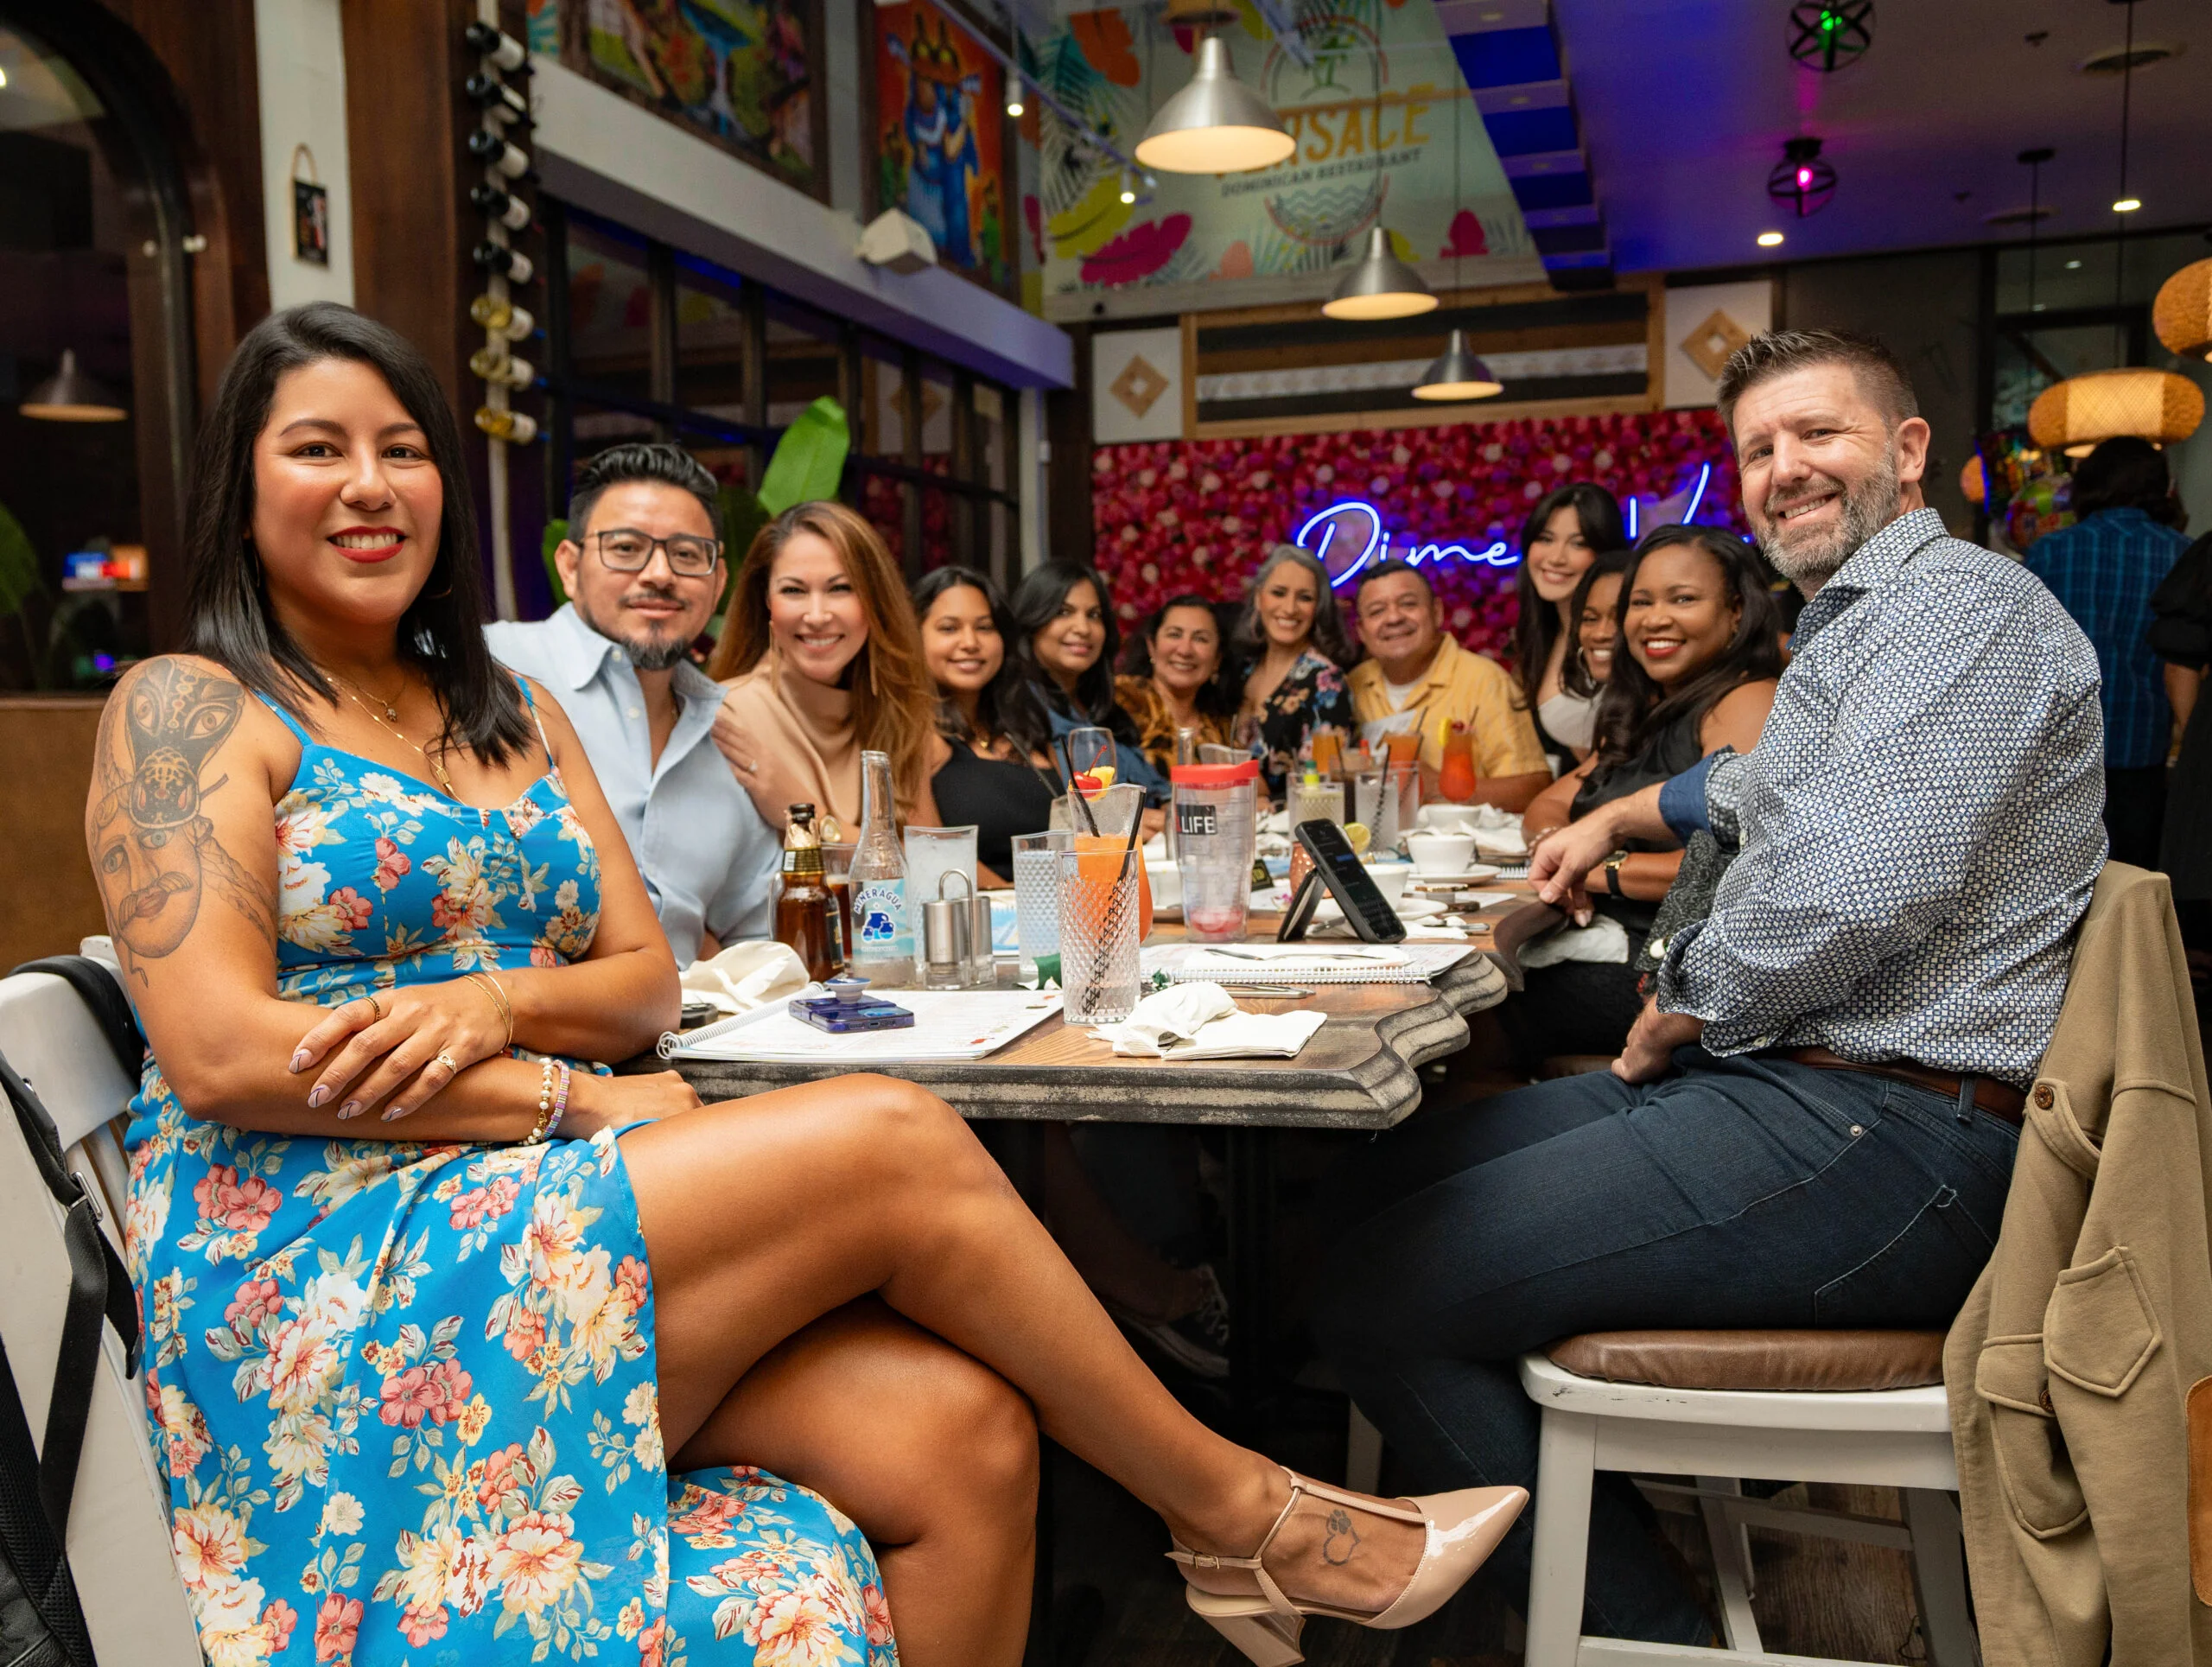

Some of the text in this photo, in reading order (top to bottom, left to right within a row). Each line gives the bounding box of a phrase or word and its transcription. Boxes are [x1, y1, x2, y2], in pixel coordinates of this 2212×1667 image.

[1221, 147, 1421, 197] DOMINICAN RESTAURANT
[1295, 500, 1521, 589] Dime
[1181, 816, 1216, 834] LIFE
[854, 888, 903, 913] MINERAGUA
